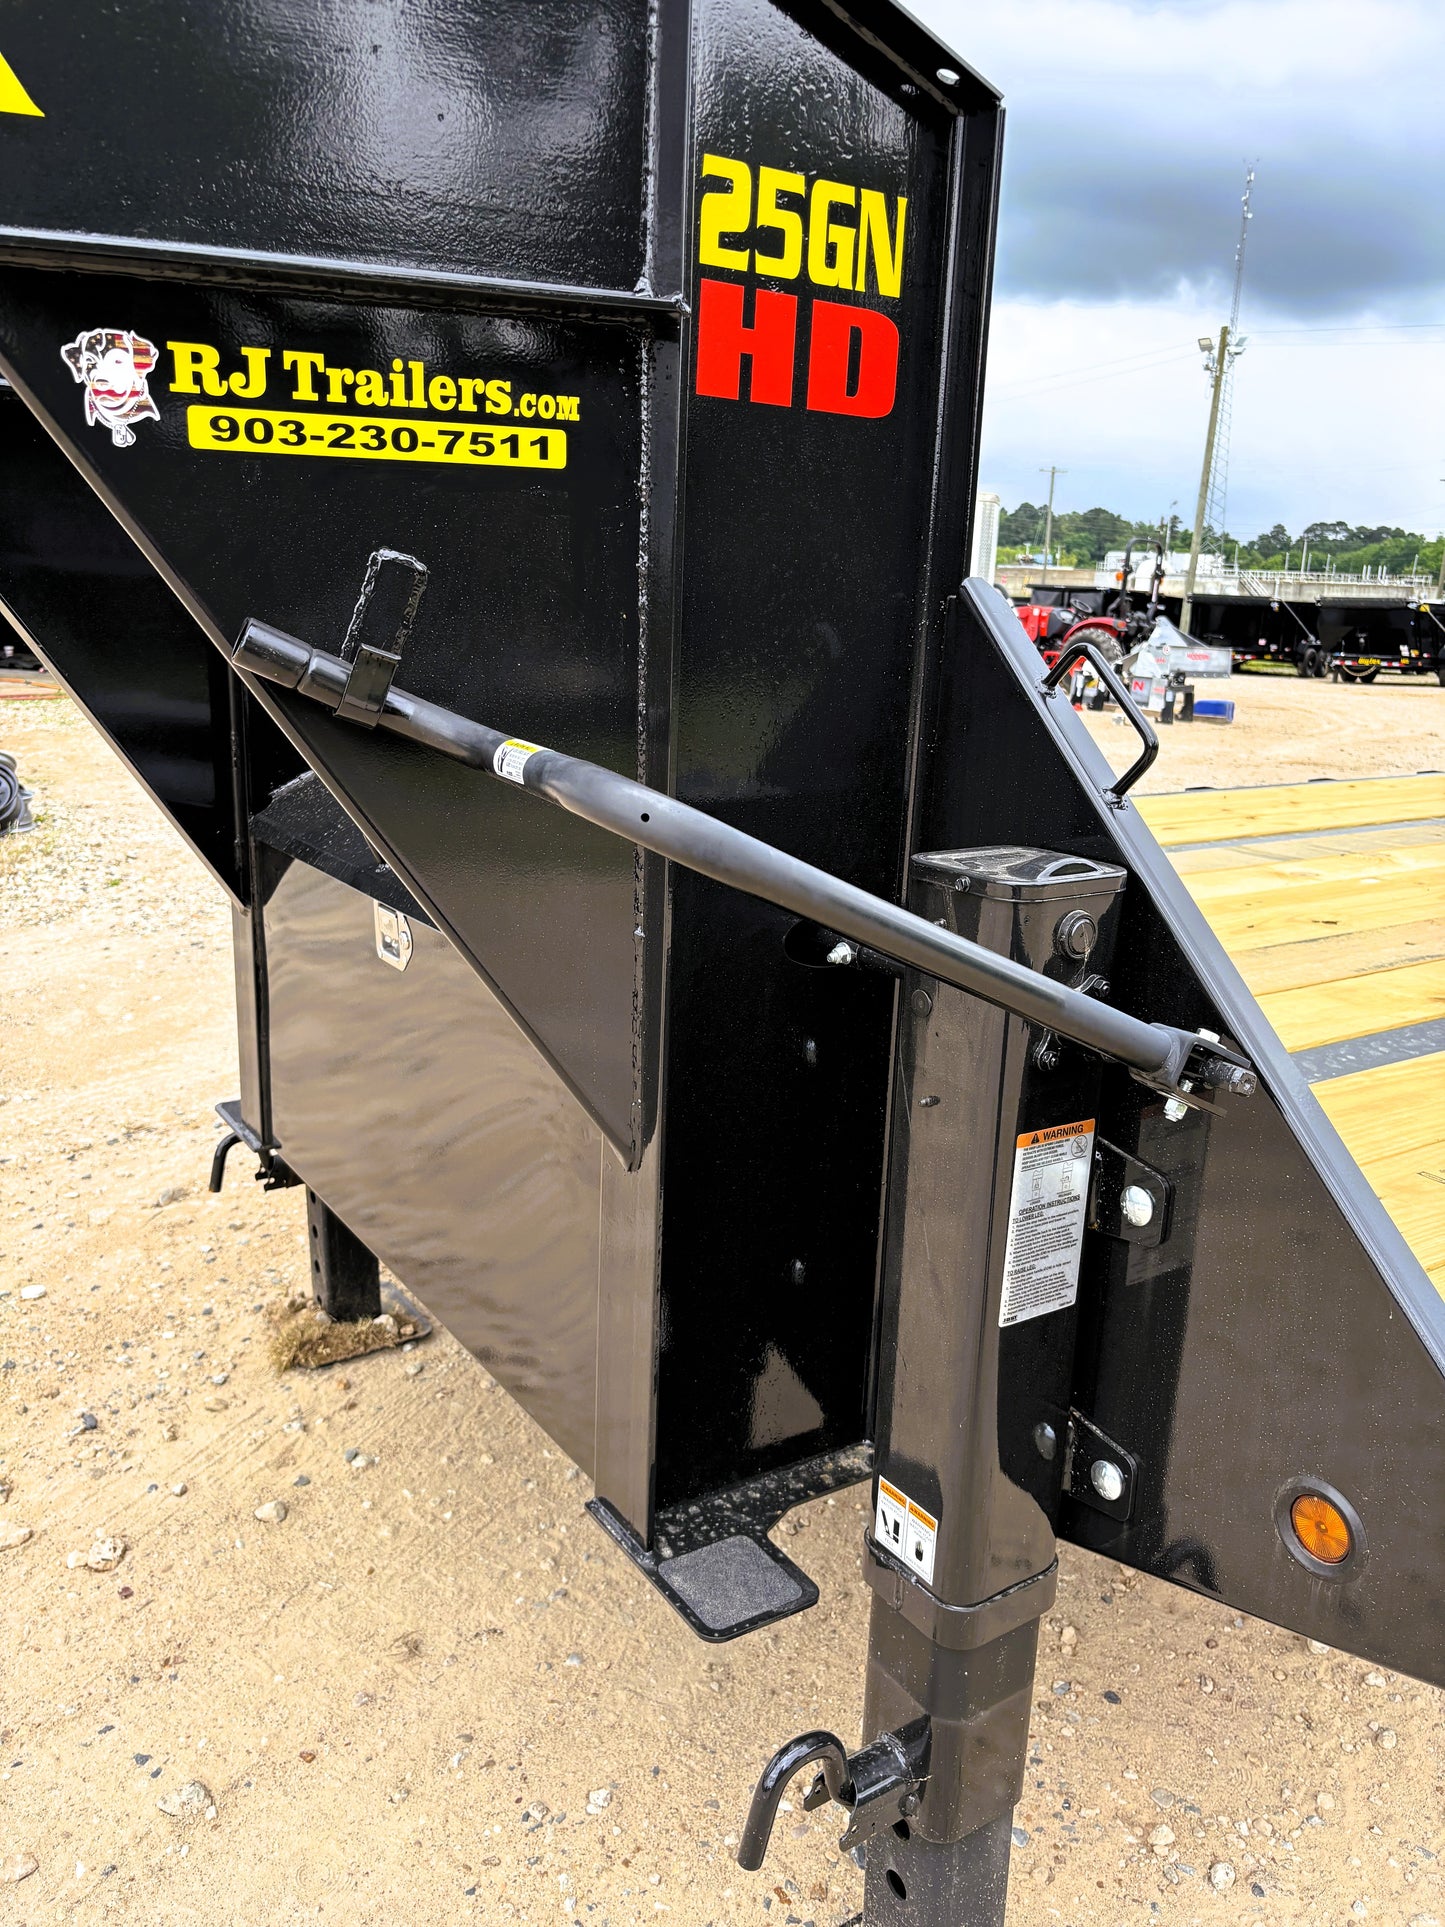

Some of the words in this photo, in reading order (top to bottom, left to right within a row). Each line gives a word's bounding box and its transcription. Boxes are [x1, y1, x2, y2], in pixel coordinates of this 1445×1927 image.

[698, 153, 908, 299] 25GN
[166, 340, 272, 399] RJ
[695, 277, 900, 419] HD
[209, 415, 549, 461] 903-230-7511
[1043, 1124, 1084, 1140] WARNING
[1018, 1203, 1046, 1216] OPERATION
[1046, 1194, 1081, 1208] INSTRUCTIONS
